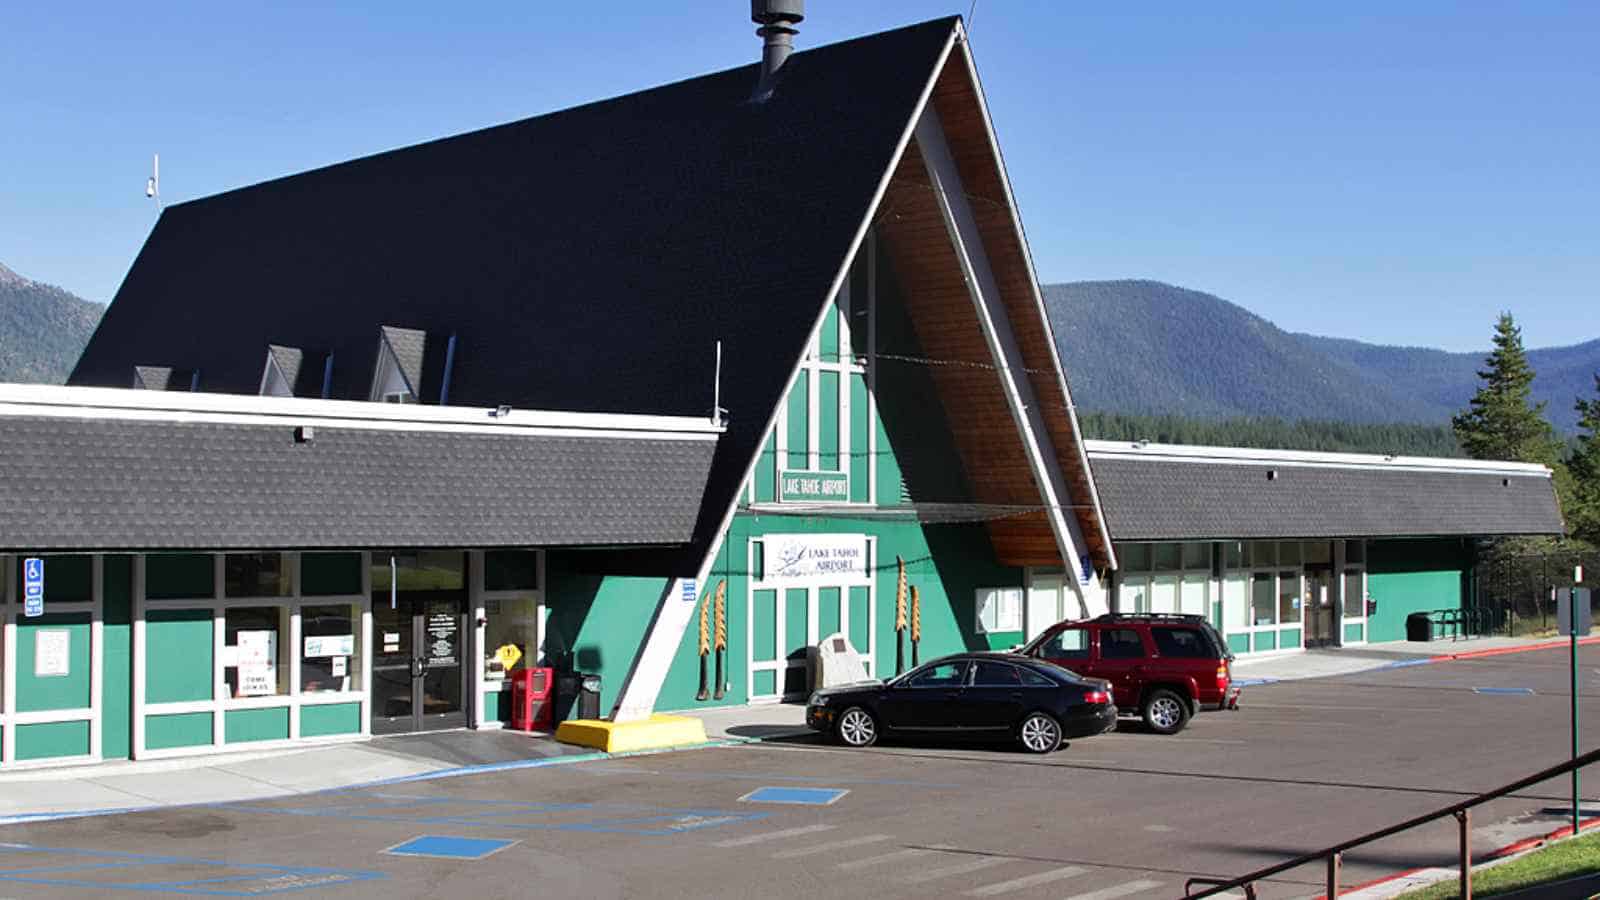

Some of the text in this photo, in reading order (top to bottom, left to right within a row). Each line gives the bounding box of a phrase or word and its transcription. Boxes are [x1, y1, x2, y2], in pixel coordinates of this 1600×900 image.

[783, 479, 847, 495] LAKE TAHOE AIRPORT
[808, 549, 859, 558] LAKE TAHOE
[816, 560, 853, 570] AIRPORT
